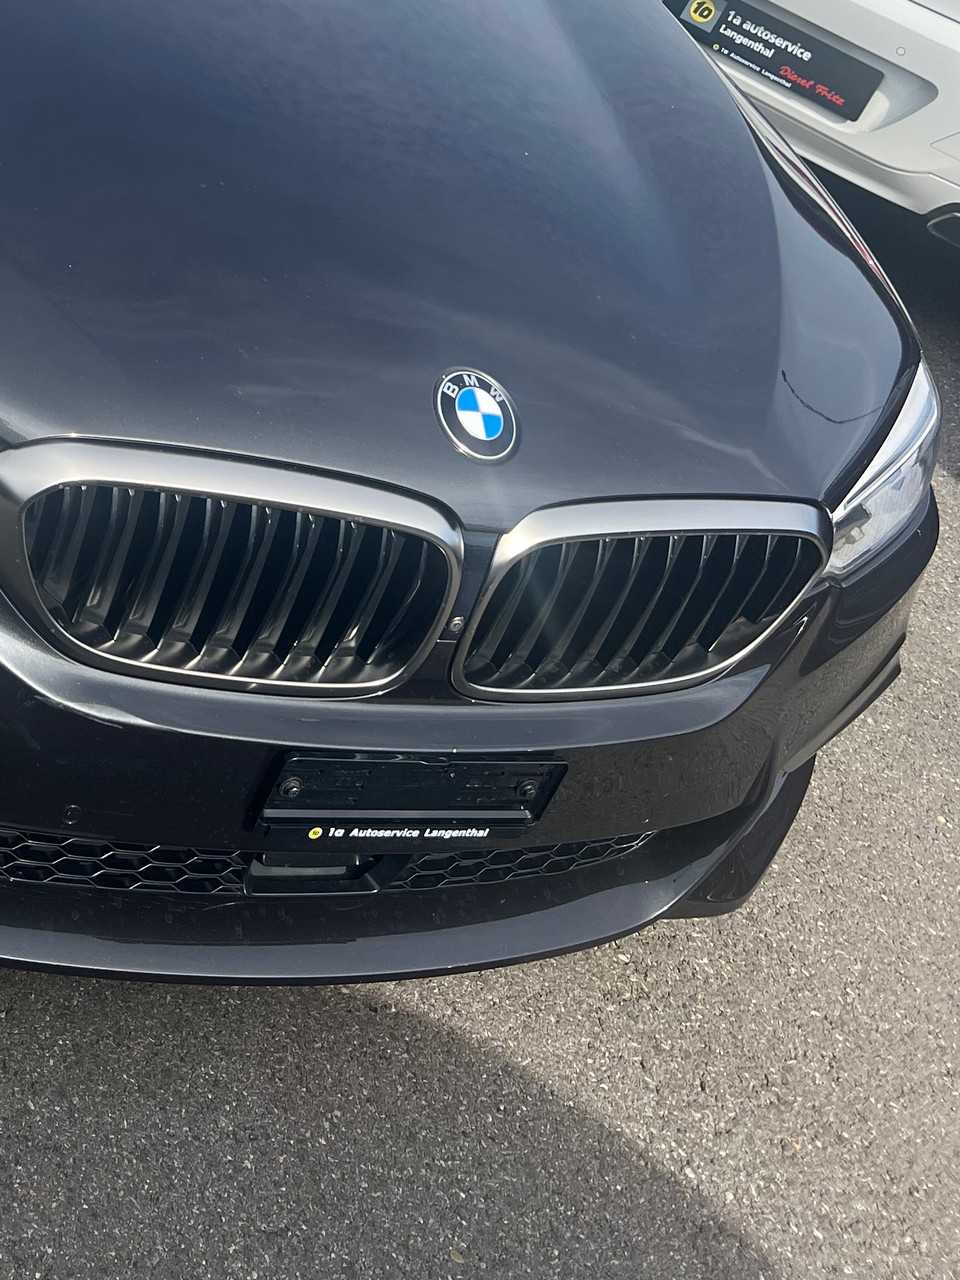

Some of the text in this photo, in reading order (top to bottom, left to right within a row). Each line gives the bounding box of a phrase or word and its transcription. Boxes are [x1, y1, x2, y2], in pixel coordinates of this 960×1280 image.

[719, 24, 775, 58] Langenthal
[727, 10, 812, 62] 1a autoservice
[729, 52, 761, 72] Autoservice
[761, 68, 792, 88] Langenthal
[779, 65, 846, 106] Diesel Fritz
[442, 374, 504, 403] BMW
[328, 827, 490, 839] 1a Autoservice Langenthal
